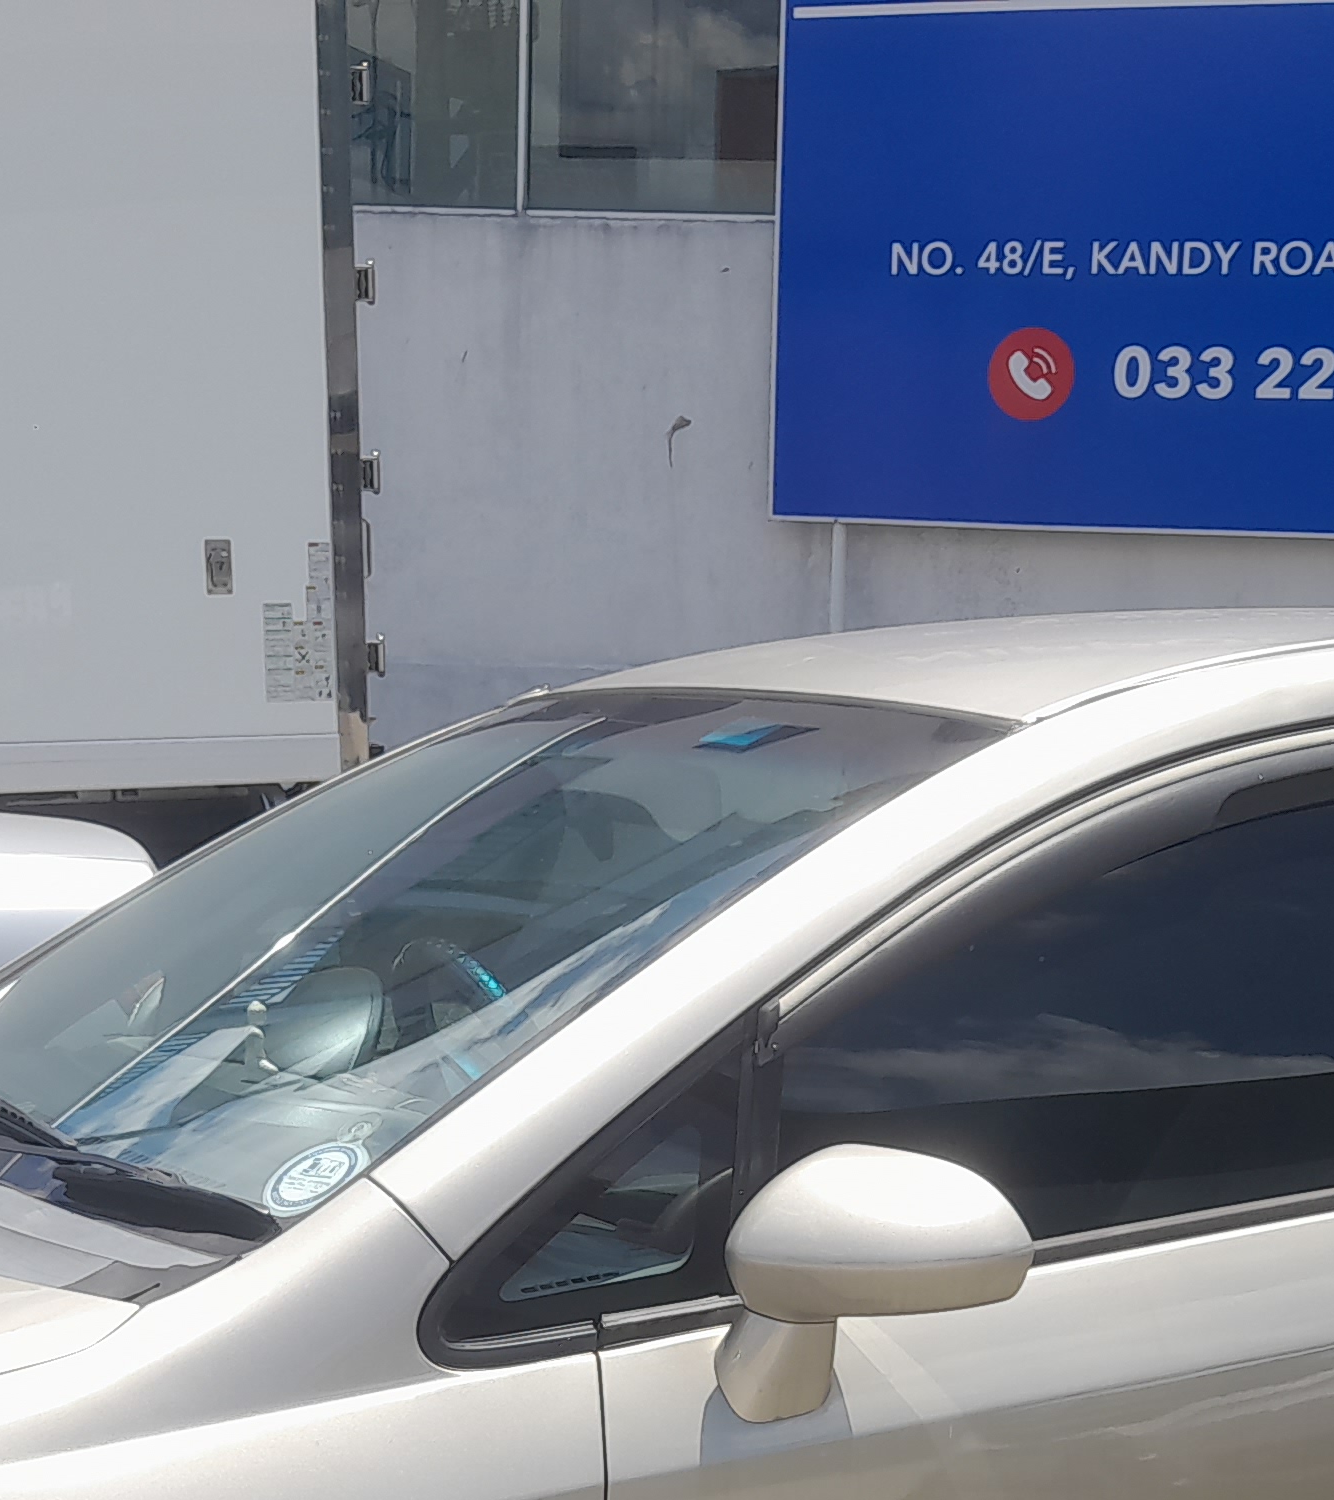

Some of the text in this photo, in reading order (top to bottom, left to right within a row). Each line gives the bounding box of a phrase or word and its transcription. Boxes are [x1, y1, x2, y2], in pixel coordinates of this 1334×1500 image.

[890, 241, 963, 276] NO.
[977, 239, 1075, 280] 48/E,
[1090, 241, 1241, 275] KANDY
[1113, 345, 1234, 400] 033
